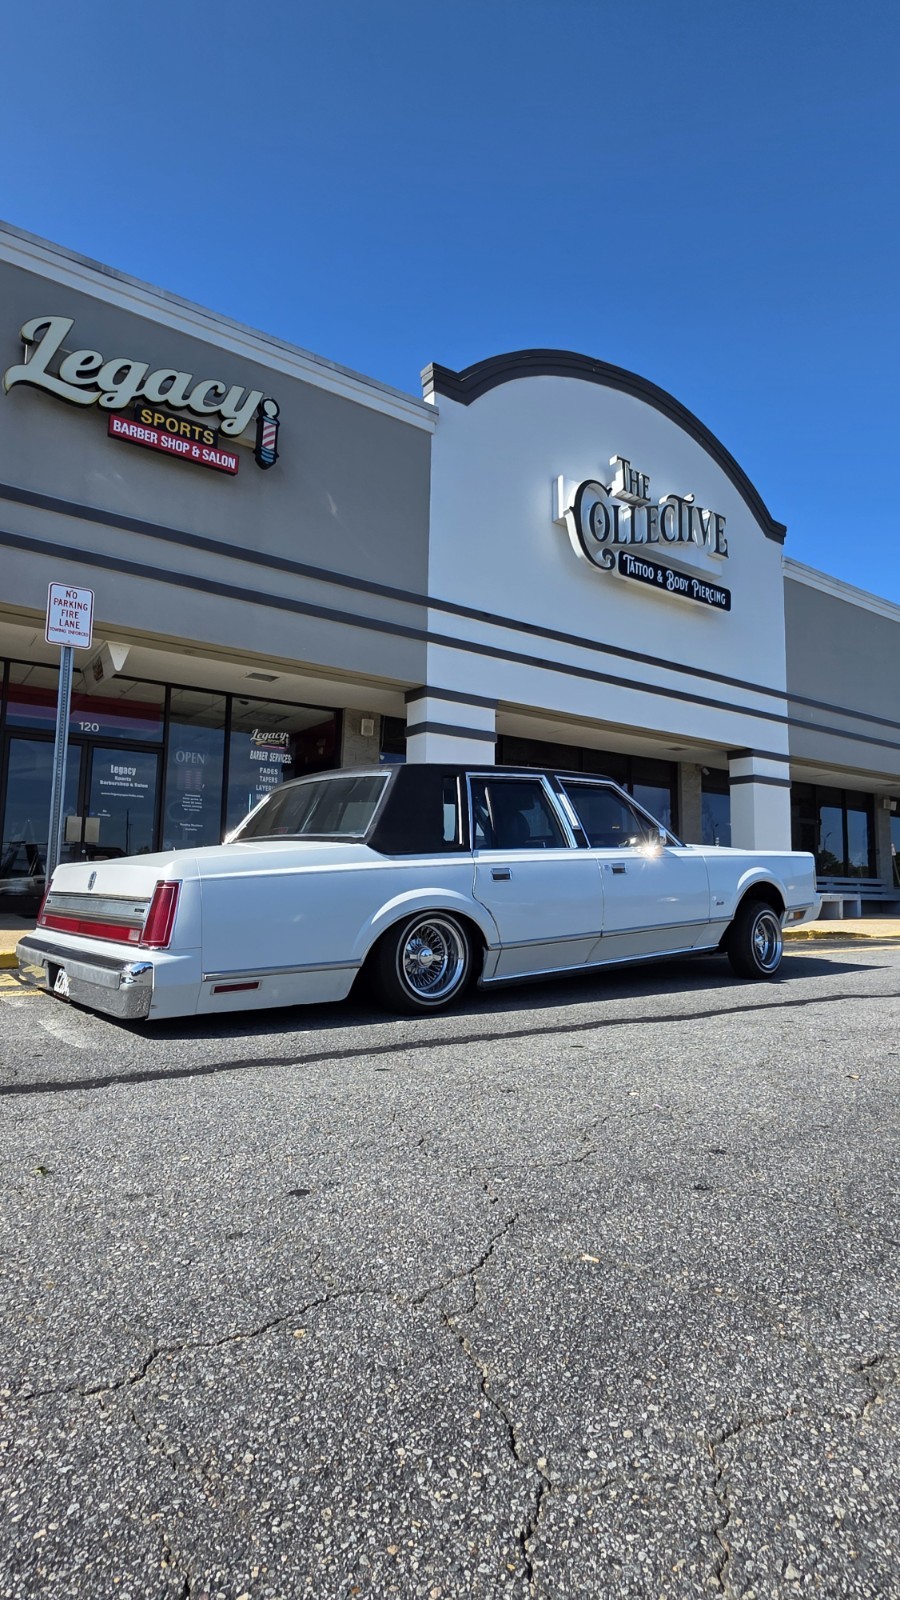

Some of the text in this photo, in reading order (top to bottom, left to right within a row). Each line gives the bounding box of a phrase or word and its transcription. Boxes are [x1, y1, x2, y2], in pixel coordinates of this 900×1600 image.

[3, 315, 265, 436] Legacy
[140, 409, 215, 445] SPORTS
[113, 418, 236, 470] BARBER SHOP & SALON
[616, 455, 651, 502] THE
[568, 479, 730, 571] COLLECTIVE
[622, 553, 727, 605] TATTOO & BODY PIERCING
[65, 590, 78, 600] NO
[53, 597, 89, 612] PARKING
[61, 609, 80, 620] FIRE
[59, 618, 81, 630] LANE
[79, 721, 100, 732] 120
[249, 728, 287, 743] Legacy
[175, 750, 205, 765] OPEN
[249, 750, 269, 761] BARBER
[110, 764, 137, 776] Legacy
[259, 767, 279, 775] FADES
